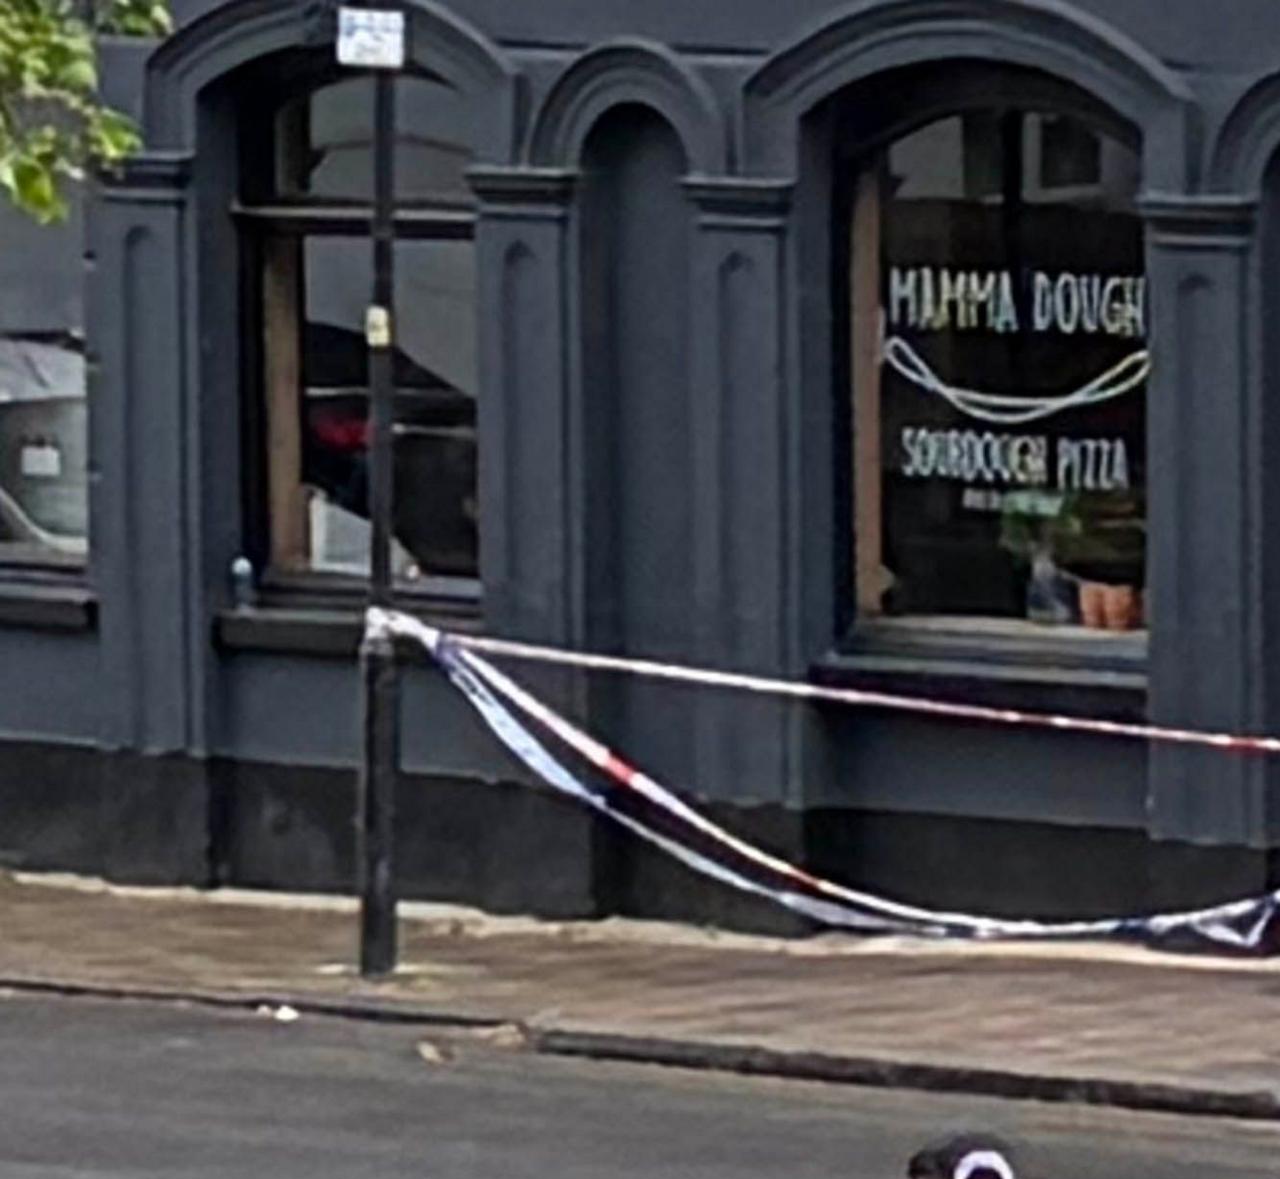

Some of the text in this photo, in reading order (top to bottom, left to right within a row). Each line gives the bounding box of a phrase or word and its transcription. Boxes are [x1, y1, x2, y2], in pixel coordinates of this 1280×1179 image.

[889, 266, 1147, 337] MAMMA DOUGH
[1057, 436, 1130, 491] PIZZA
